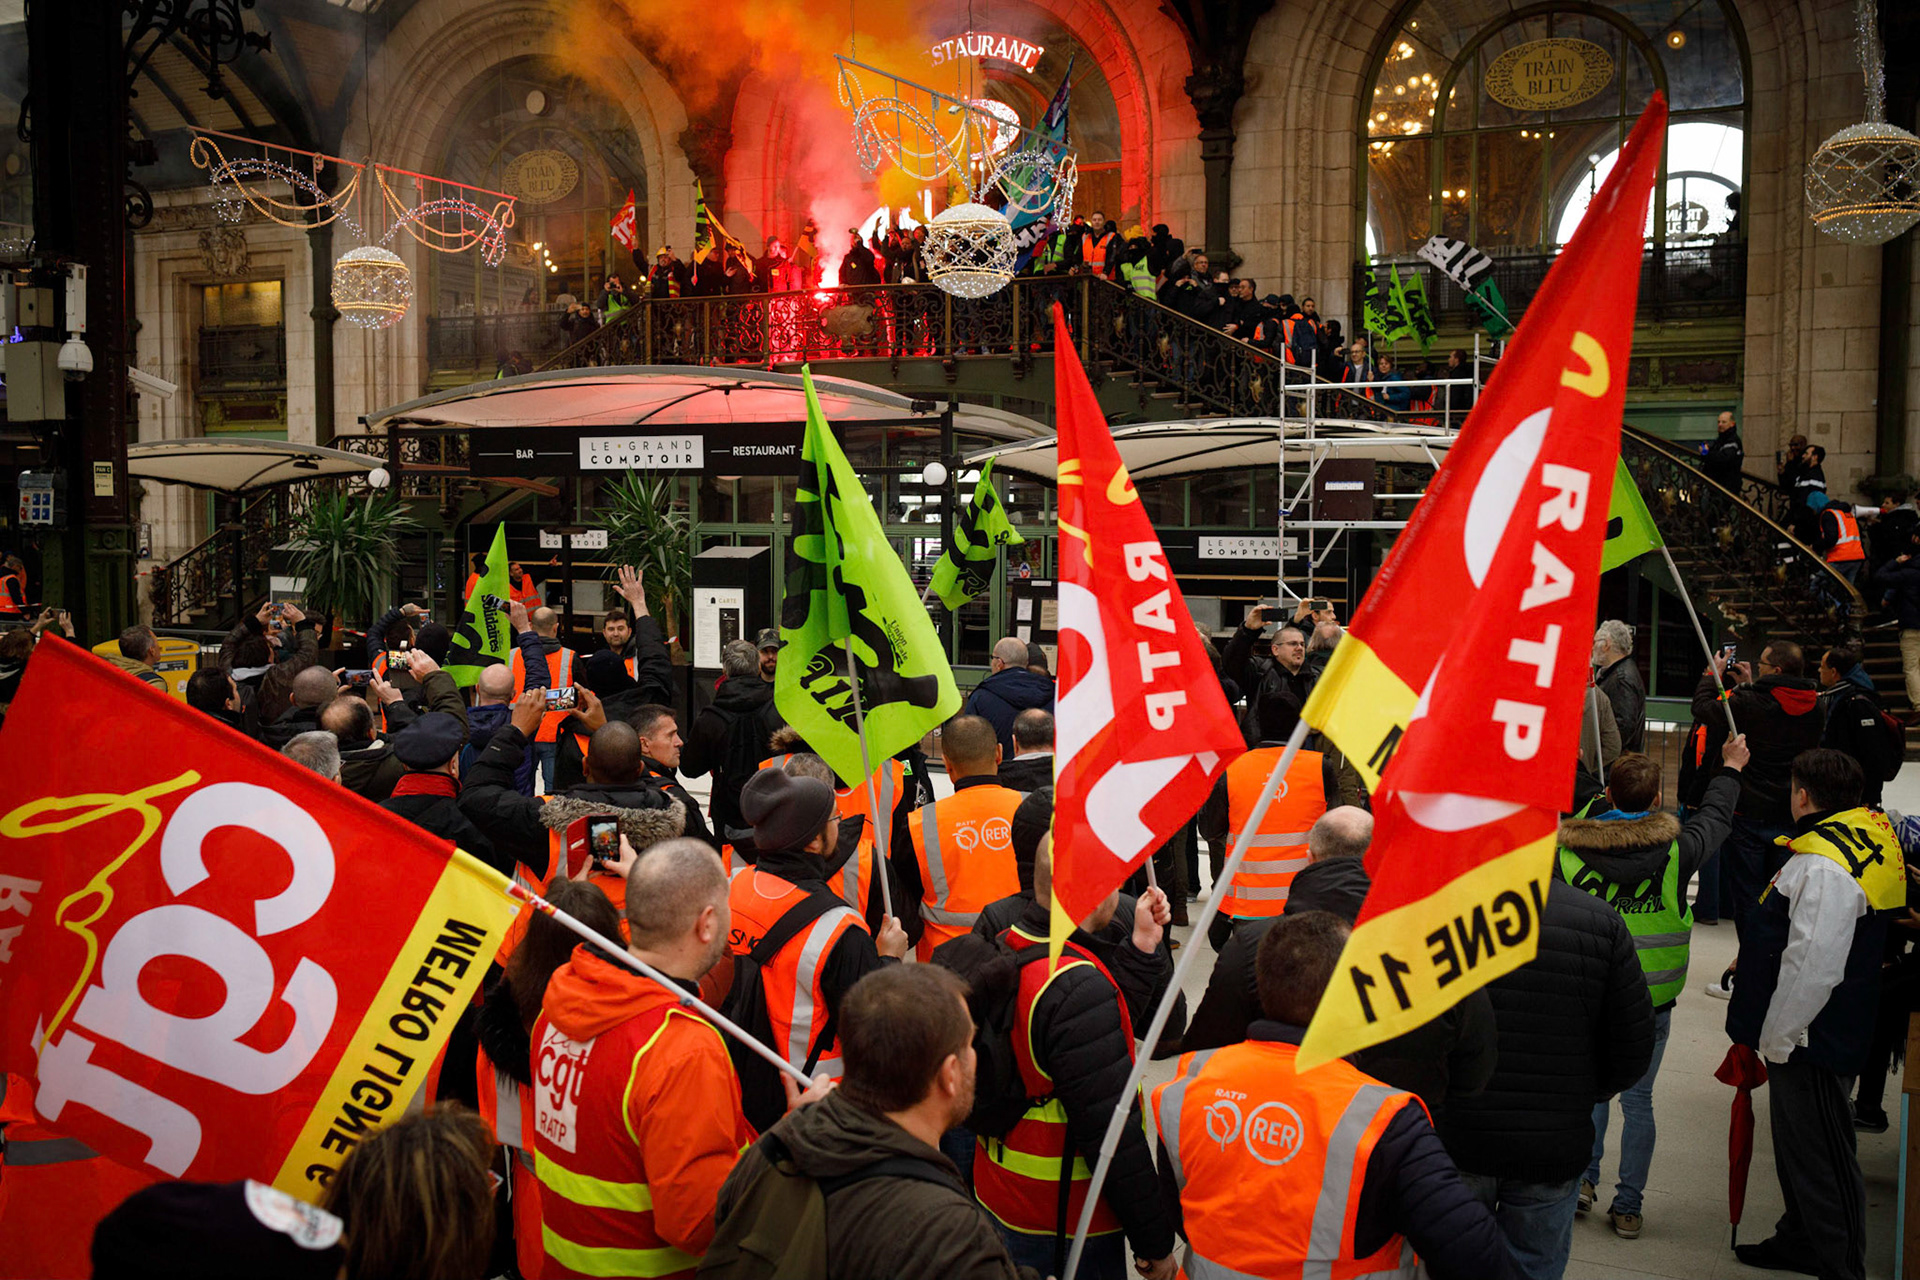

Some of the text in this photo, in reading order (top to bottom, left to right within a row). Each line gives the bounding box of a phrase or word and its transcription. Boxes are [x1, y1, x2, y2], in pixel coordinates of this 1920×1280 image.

[931, 34, 1037, 68] STAURANT
[1523, 59, 1574, 77] TRAIN
[1528, 77, 1572, 95] BLEU
[525, 166, 555, 178] TRAIN
[528, 180, 554, 192] BLEU
[516, 449, 534, 459] BAR
[591, 440, 691, 451] LE GRAND
[733, 445, 796, 456] RESTAURANT
[591, 454, 692, 464] COMPTOIR
[1492, 463, 1590, 761] RATP
[890, 620, 907, 647] Union
[985, 826, 1009, 841] RER
[1616, 896, 1666, 915] Rail
[538, 1046, 588, 1111] cgt
[1215, 1088, 1247, 1101] RATP
[540, 1111, 567, 1142] RATP
[1252, 1117, 1296, 1150] RER
